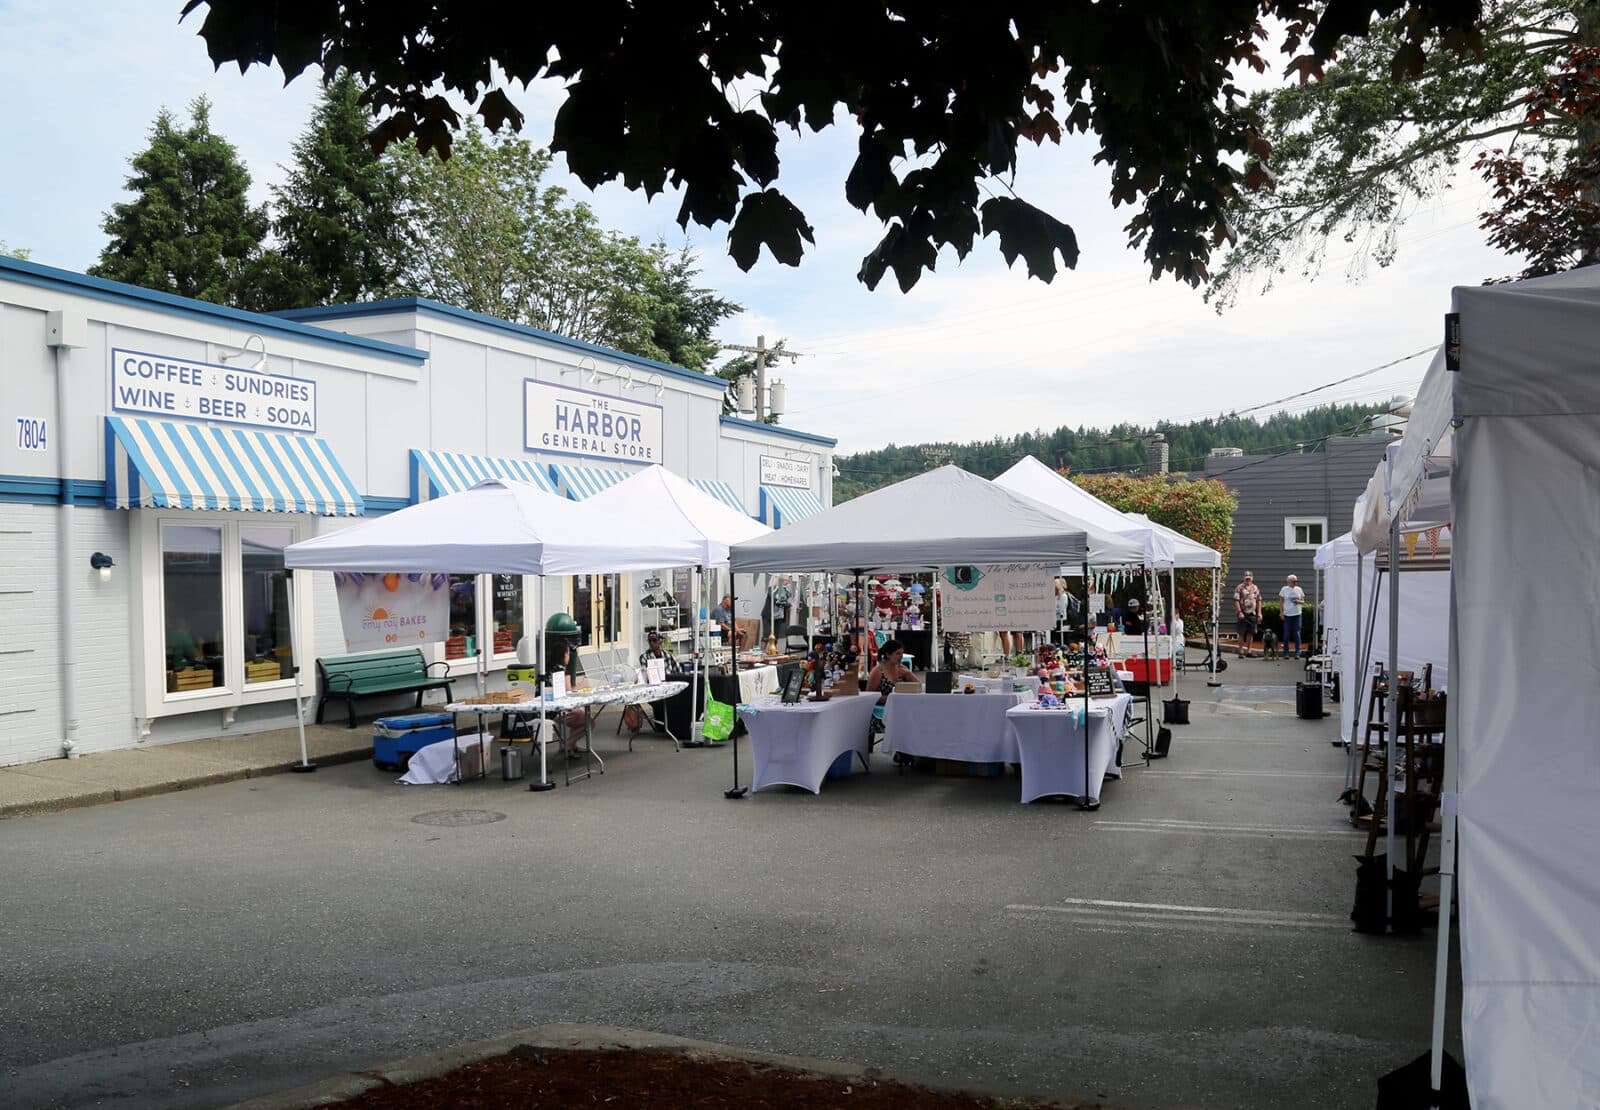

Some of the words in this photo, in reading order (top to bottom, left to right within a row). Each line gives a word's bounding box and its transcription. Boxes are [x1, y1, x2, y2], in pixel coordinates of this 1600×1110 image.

[123, 358, 202, 386] COFFEE
[225, 374, 309, 402] SUNDRIES
[119, 385, 175, 410] WINE
[199, 397, 247, 419] BEER
[267, 406, 312, 427] SODA
[592, 399, 609, 411] THE
[17, 418, 46, 449] 7804
[555, 404, 641, 442] HARBOR
[542, 432, 606, 453] GENERAL
[613, 442, 652, 459] STORE
[400, 615, 427, 626] BAKES
